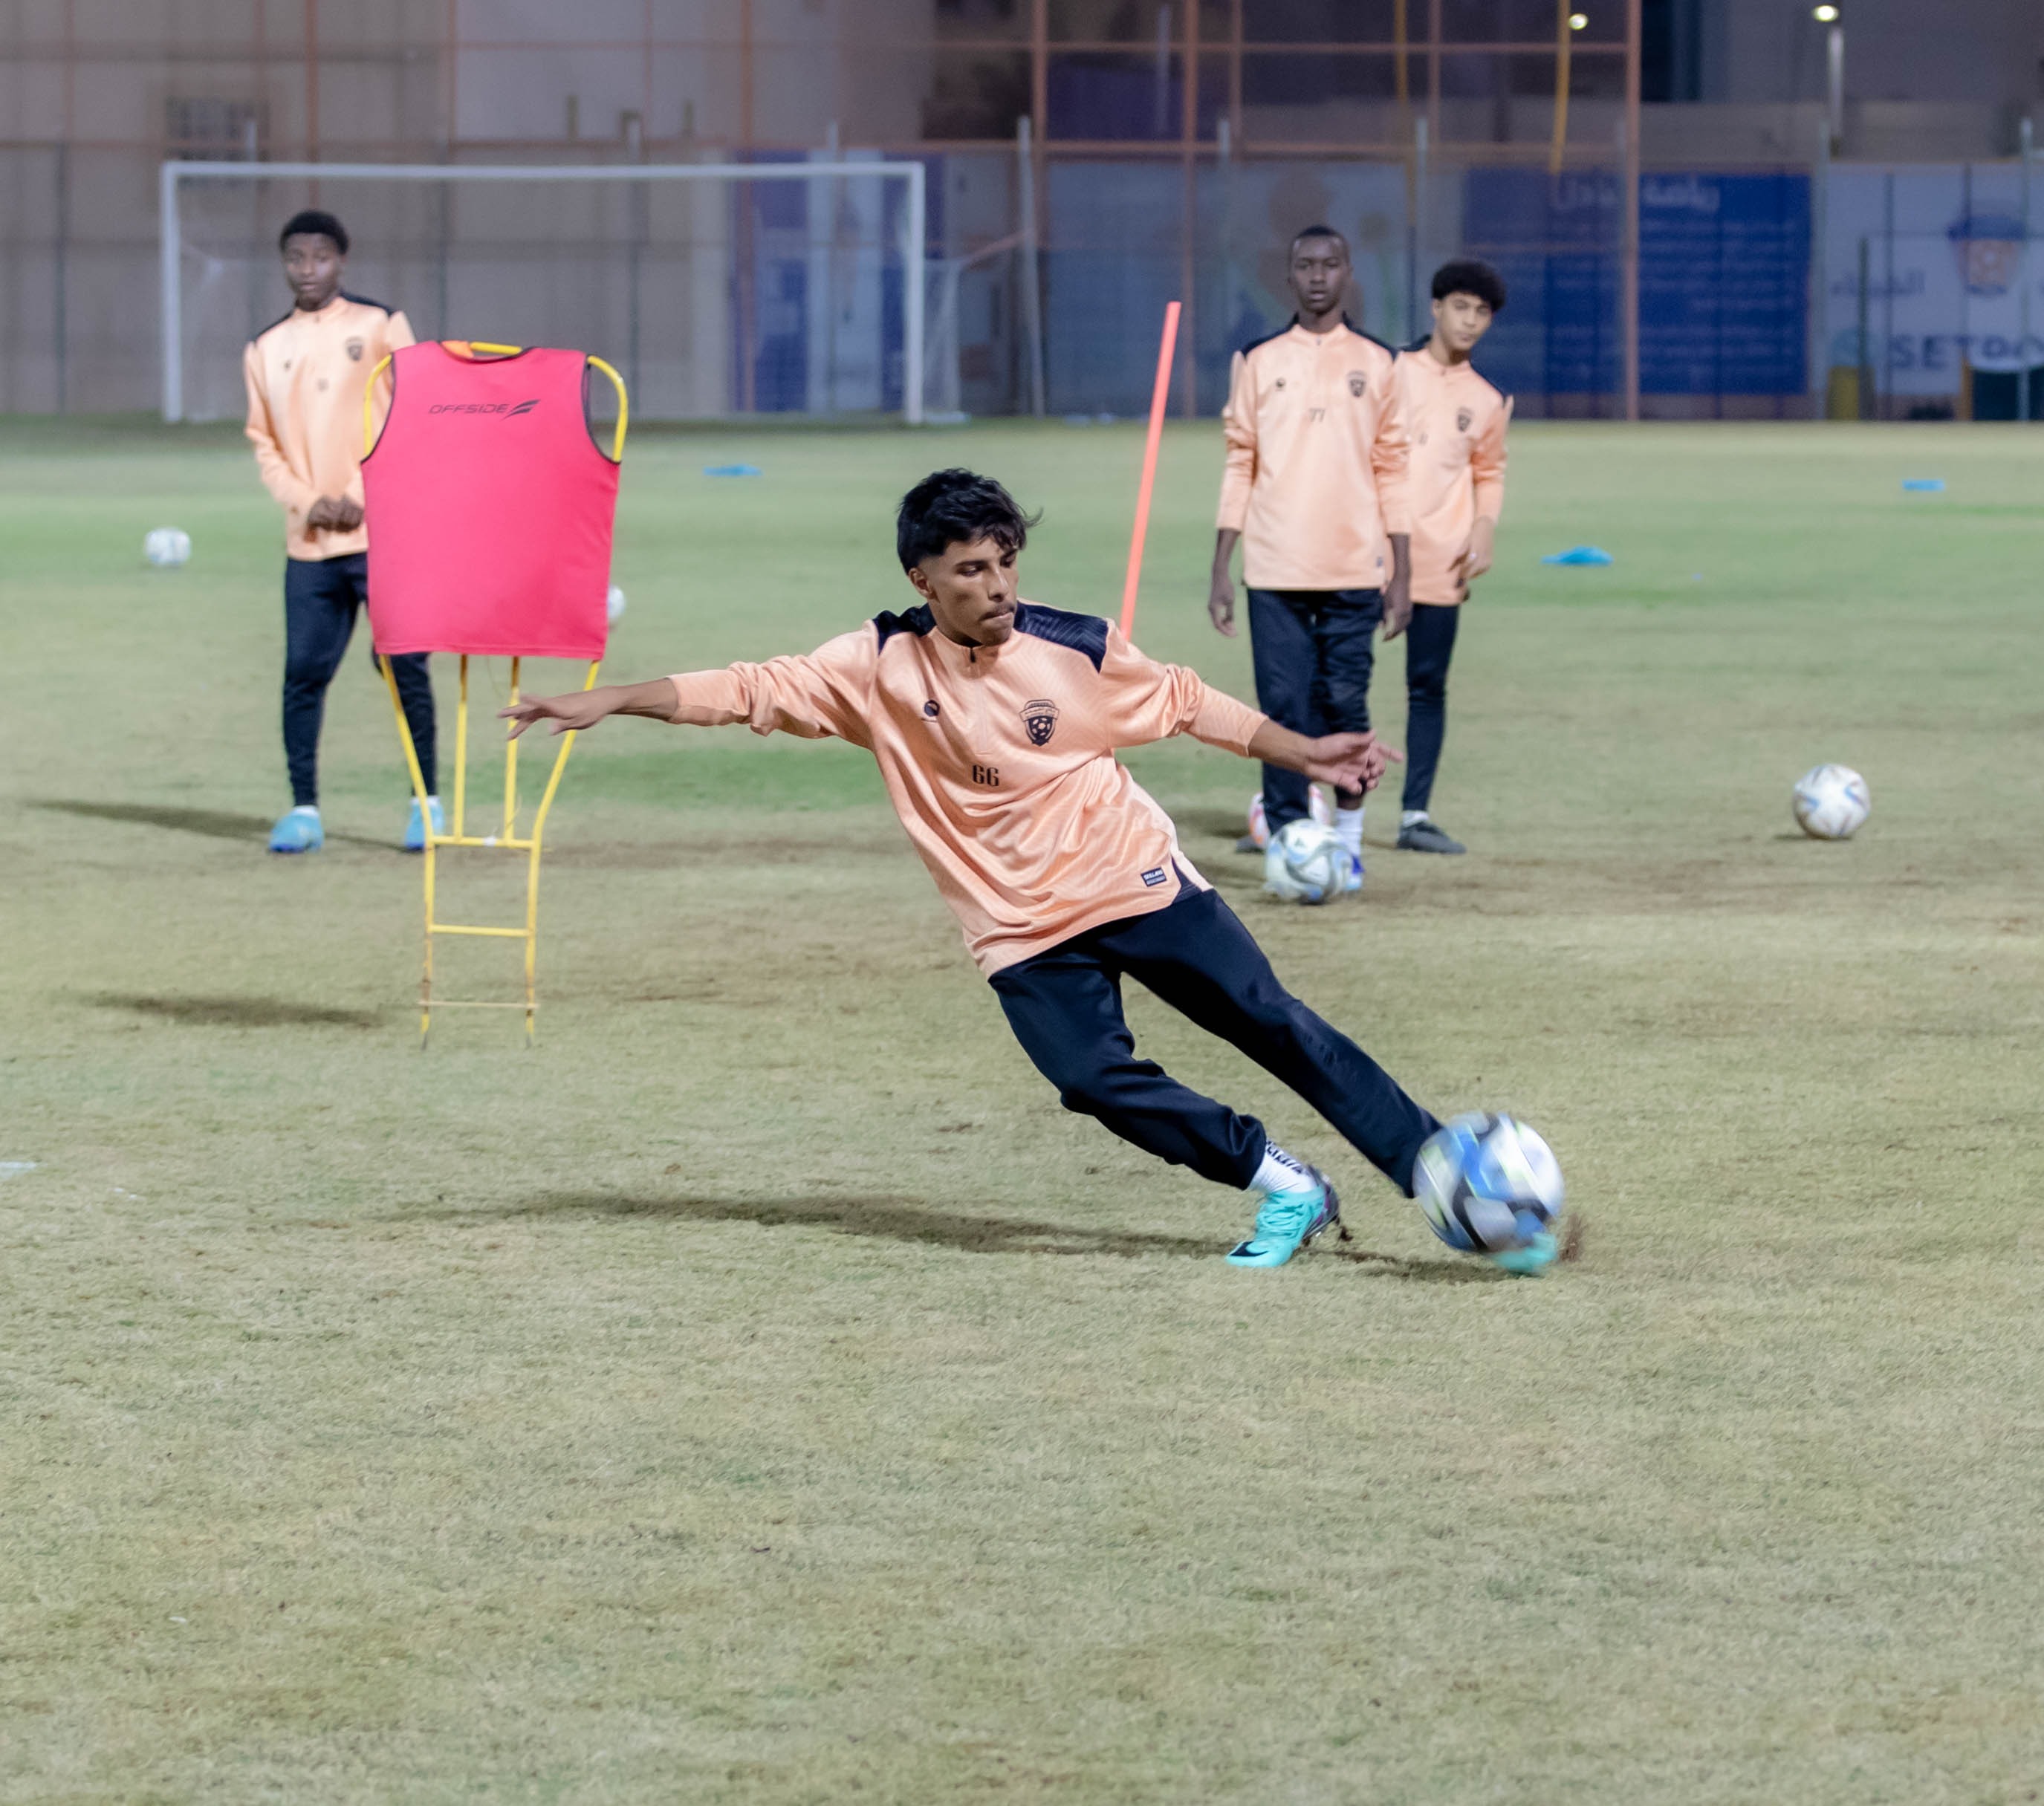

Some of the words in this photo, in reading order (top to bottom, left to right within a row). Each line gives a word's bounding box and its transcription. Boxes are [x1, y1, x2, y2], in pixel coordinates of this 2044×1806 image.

[428, 403, 510, 415] OFFSIDE
[1308, 407, 1326, 422] 77
[972, 764, 999, 787] 66
